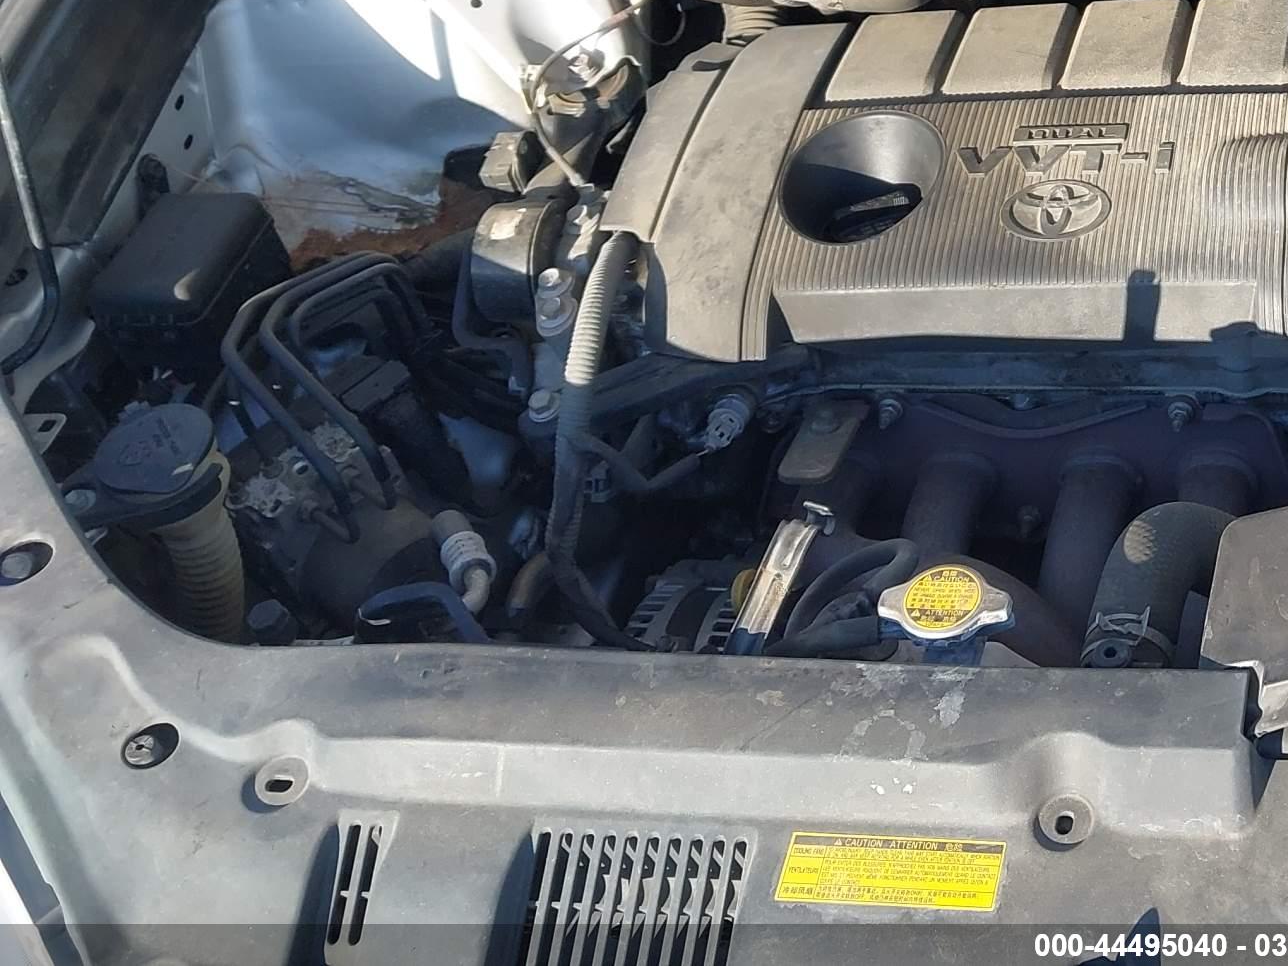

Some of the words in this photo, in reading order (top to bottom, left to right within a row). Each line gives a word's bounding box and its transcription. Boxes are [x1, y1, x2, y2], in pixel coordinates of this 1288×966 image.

[1028, 127, 1115, 139] DUAL
[933, 575, 970, 583] CAUTION
[925, 609, 964, 617] ATTENTION
[845, 838, 883, 848] CAUTION
[889, 841, 938, 850] ATTENTION
